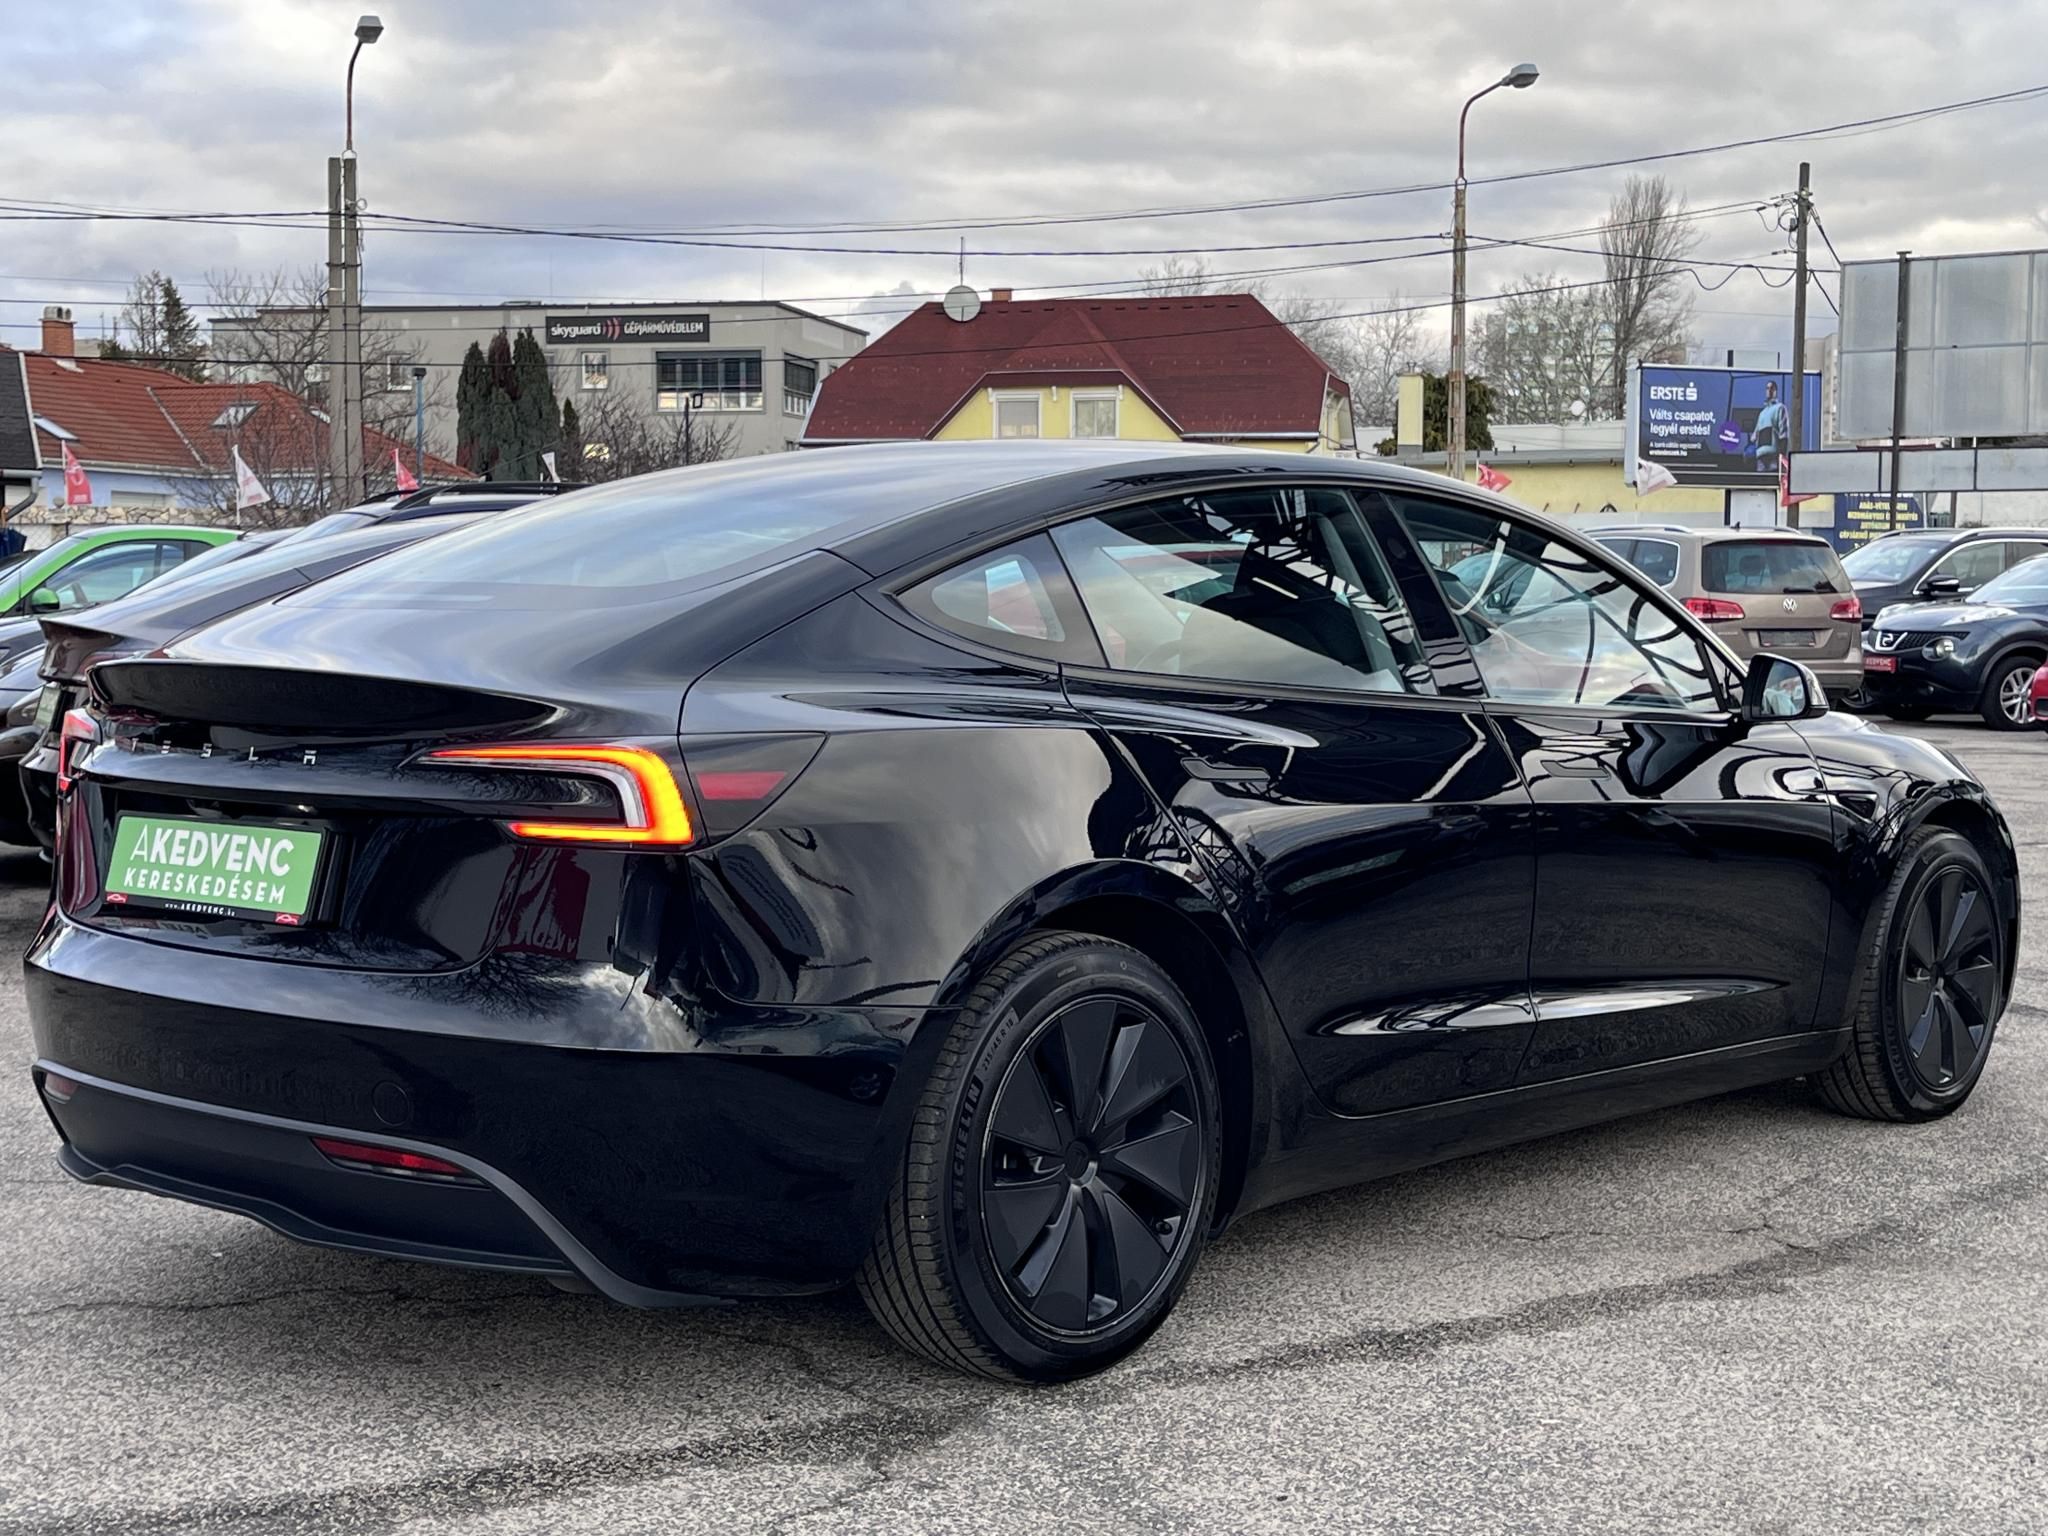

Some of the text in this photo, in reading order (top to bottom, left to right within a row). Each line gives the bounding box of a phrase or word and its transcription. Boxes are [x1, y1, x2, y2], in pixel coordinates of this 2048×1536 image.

[551, 322, 601, 338] skyguard
[1650, 386, 1684, 400] ERSTE
[1649, 407, 1716, 424] Válts csapatot,
[1650, 423, 1678, 437] legyél
[1679, 424, 1711, 436] erstés!
[131, 737, 317, 765] TESLA
[124, 868, 286, 905] KERESKEDÉSEM
[953, 1082, 982, 1210] MICHELIN
